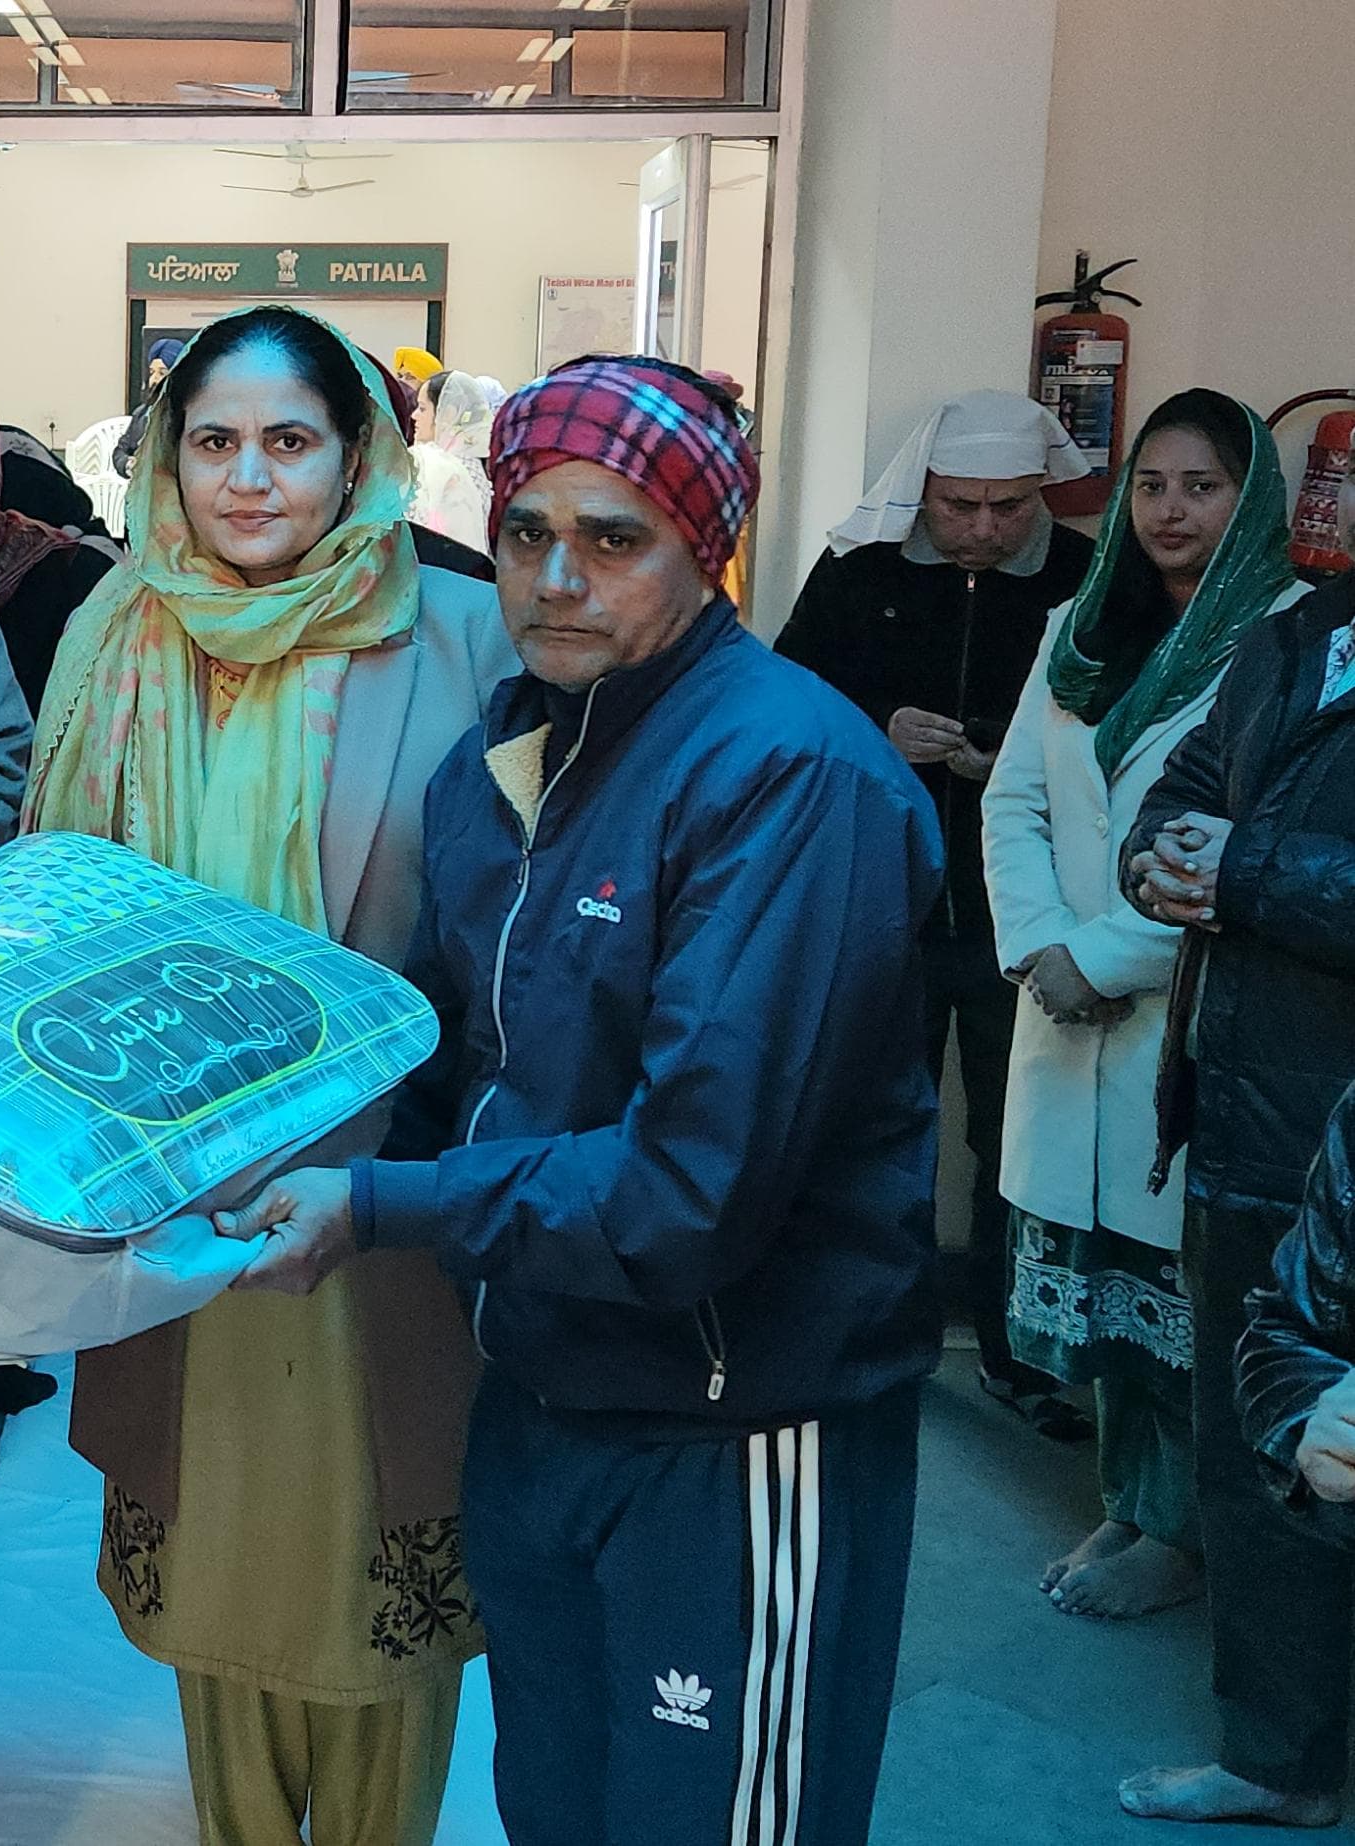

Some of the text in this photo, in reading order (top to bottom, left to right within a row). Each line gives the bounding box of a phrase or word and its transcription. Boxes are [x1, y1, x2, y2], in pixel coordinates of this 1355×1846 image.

[147, 255, 240, 282] ਪਟਿਆਲਾ
[329, 262, 427, 282] PATIALA
[574, 279, 595, 288] Wise
[596, 279, 613, 289] Map
[616, 279, 625, 288] of
[32, 959, 276, 1082] Cutie Pie
